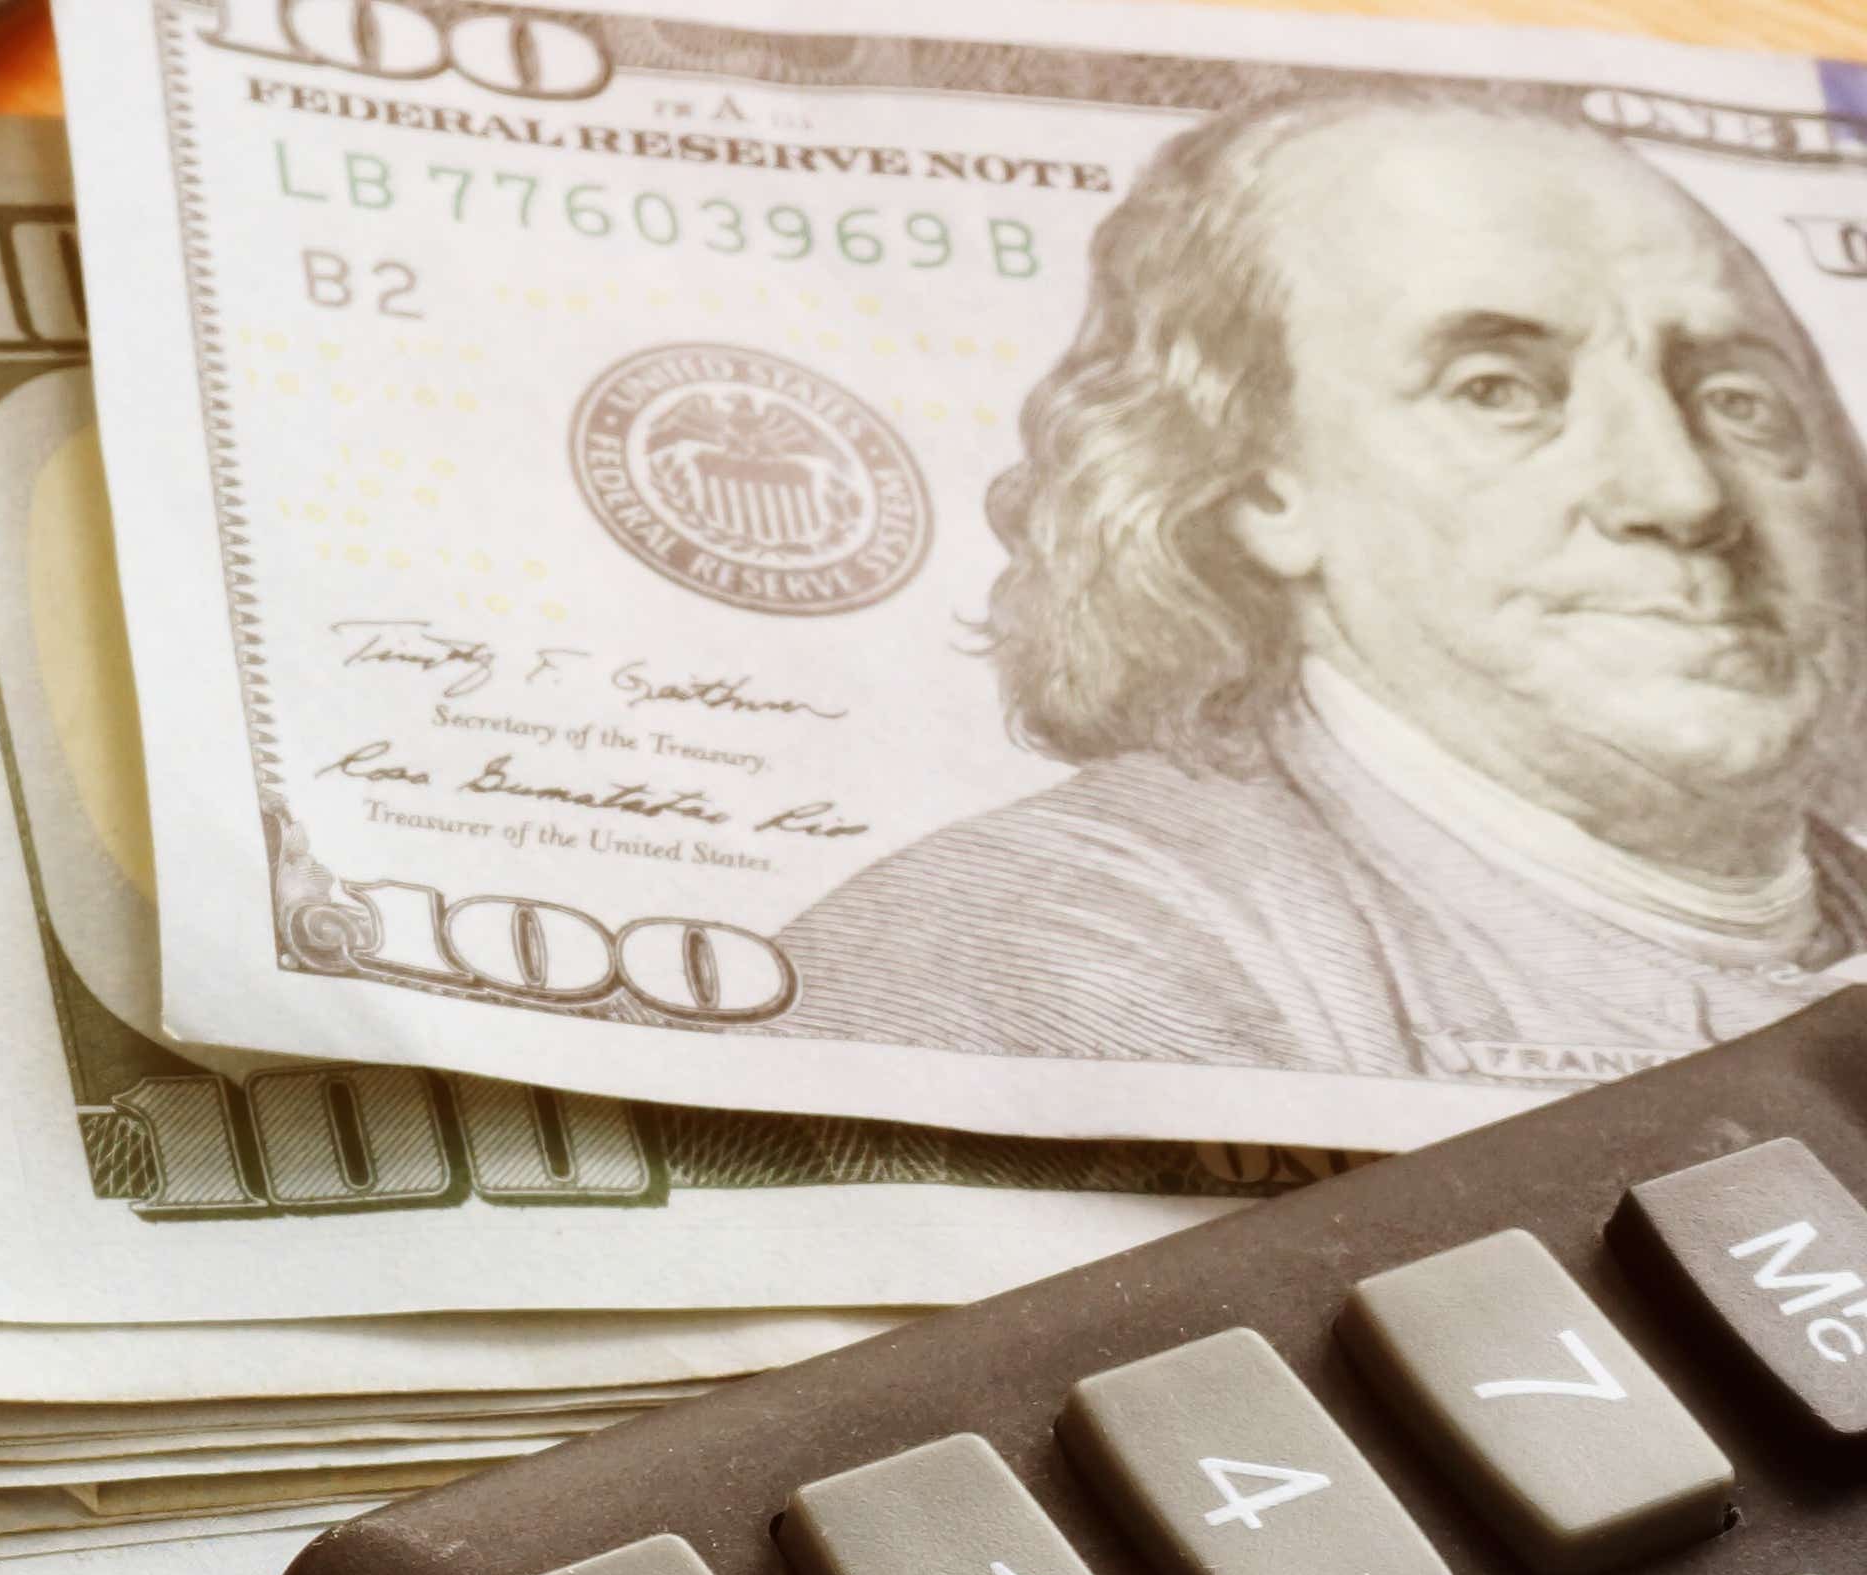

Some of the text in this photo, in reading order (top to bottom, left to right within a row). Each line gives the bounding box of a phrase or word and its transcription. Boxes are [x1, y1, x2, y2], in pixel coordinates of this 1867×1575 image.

[246, 77, 1114, 193] FEDERAL RESERVE NOTE
[428, 162, 953, 270] 77603969
[988, 217, 1041, 280] B
[303, 248, 425, 320] B2
[432, 703, 556, 745] Secretary
[566, 721, 594, 750] of
[600, 727, 639, 751] the
[363, 798, 495, 840] Treasurer
[502, 820, 529, 848] of
[537, 824, 579, 850] the
[589, 828, 683, 862] United
[340, 878, 802, 1026] 100
[112, 1060, 669, 1222] 100
[1474, 1328, 1629, 1401] 7
[1197, 1456, 1333, 1530] 4
